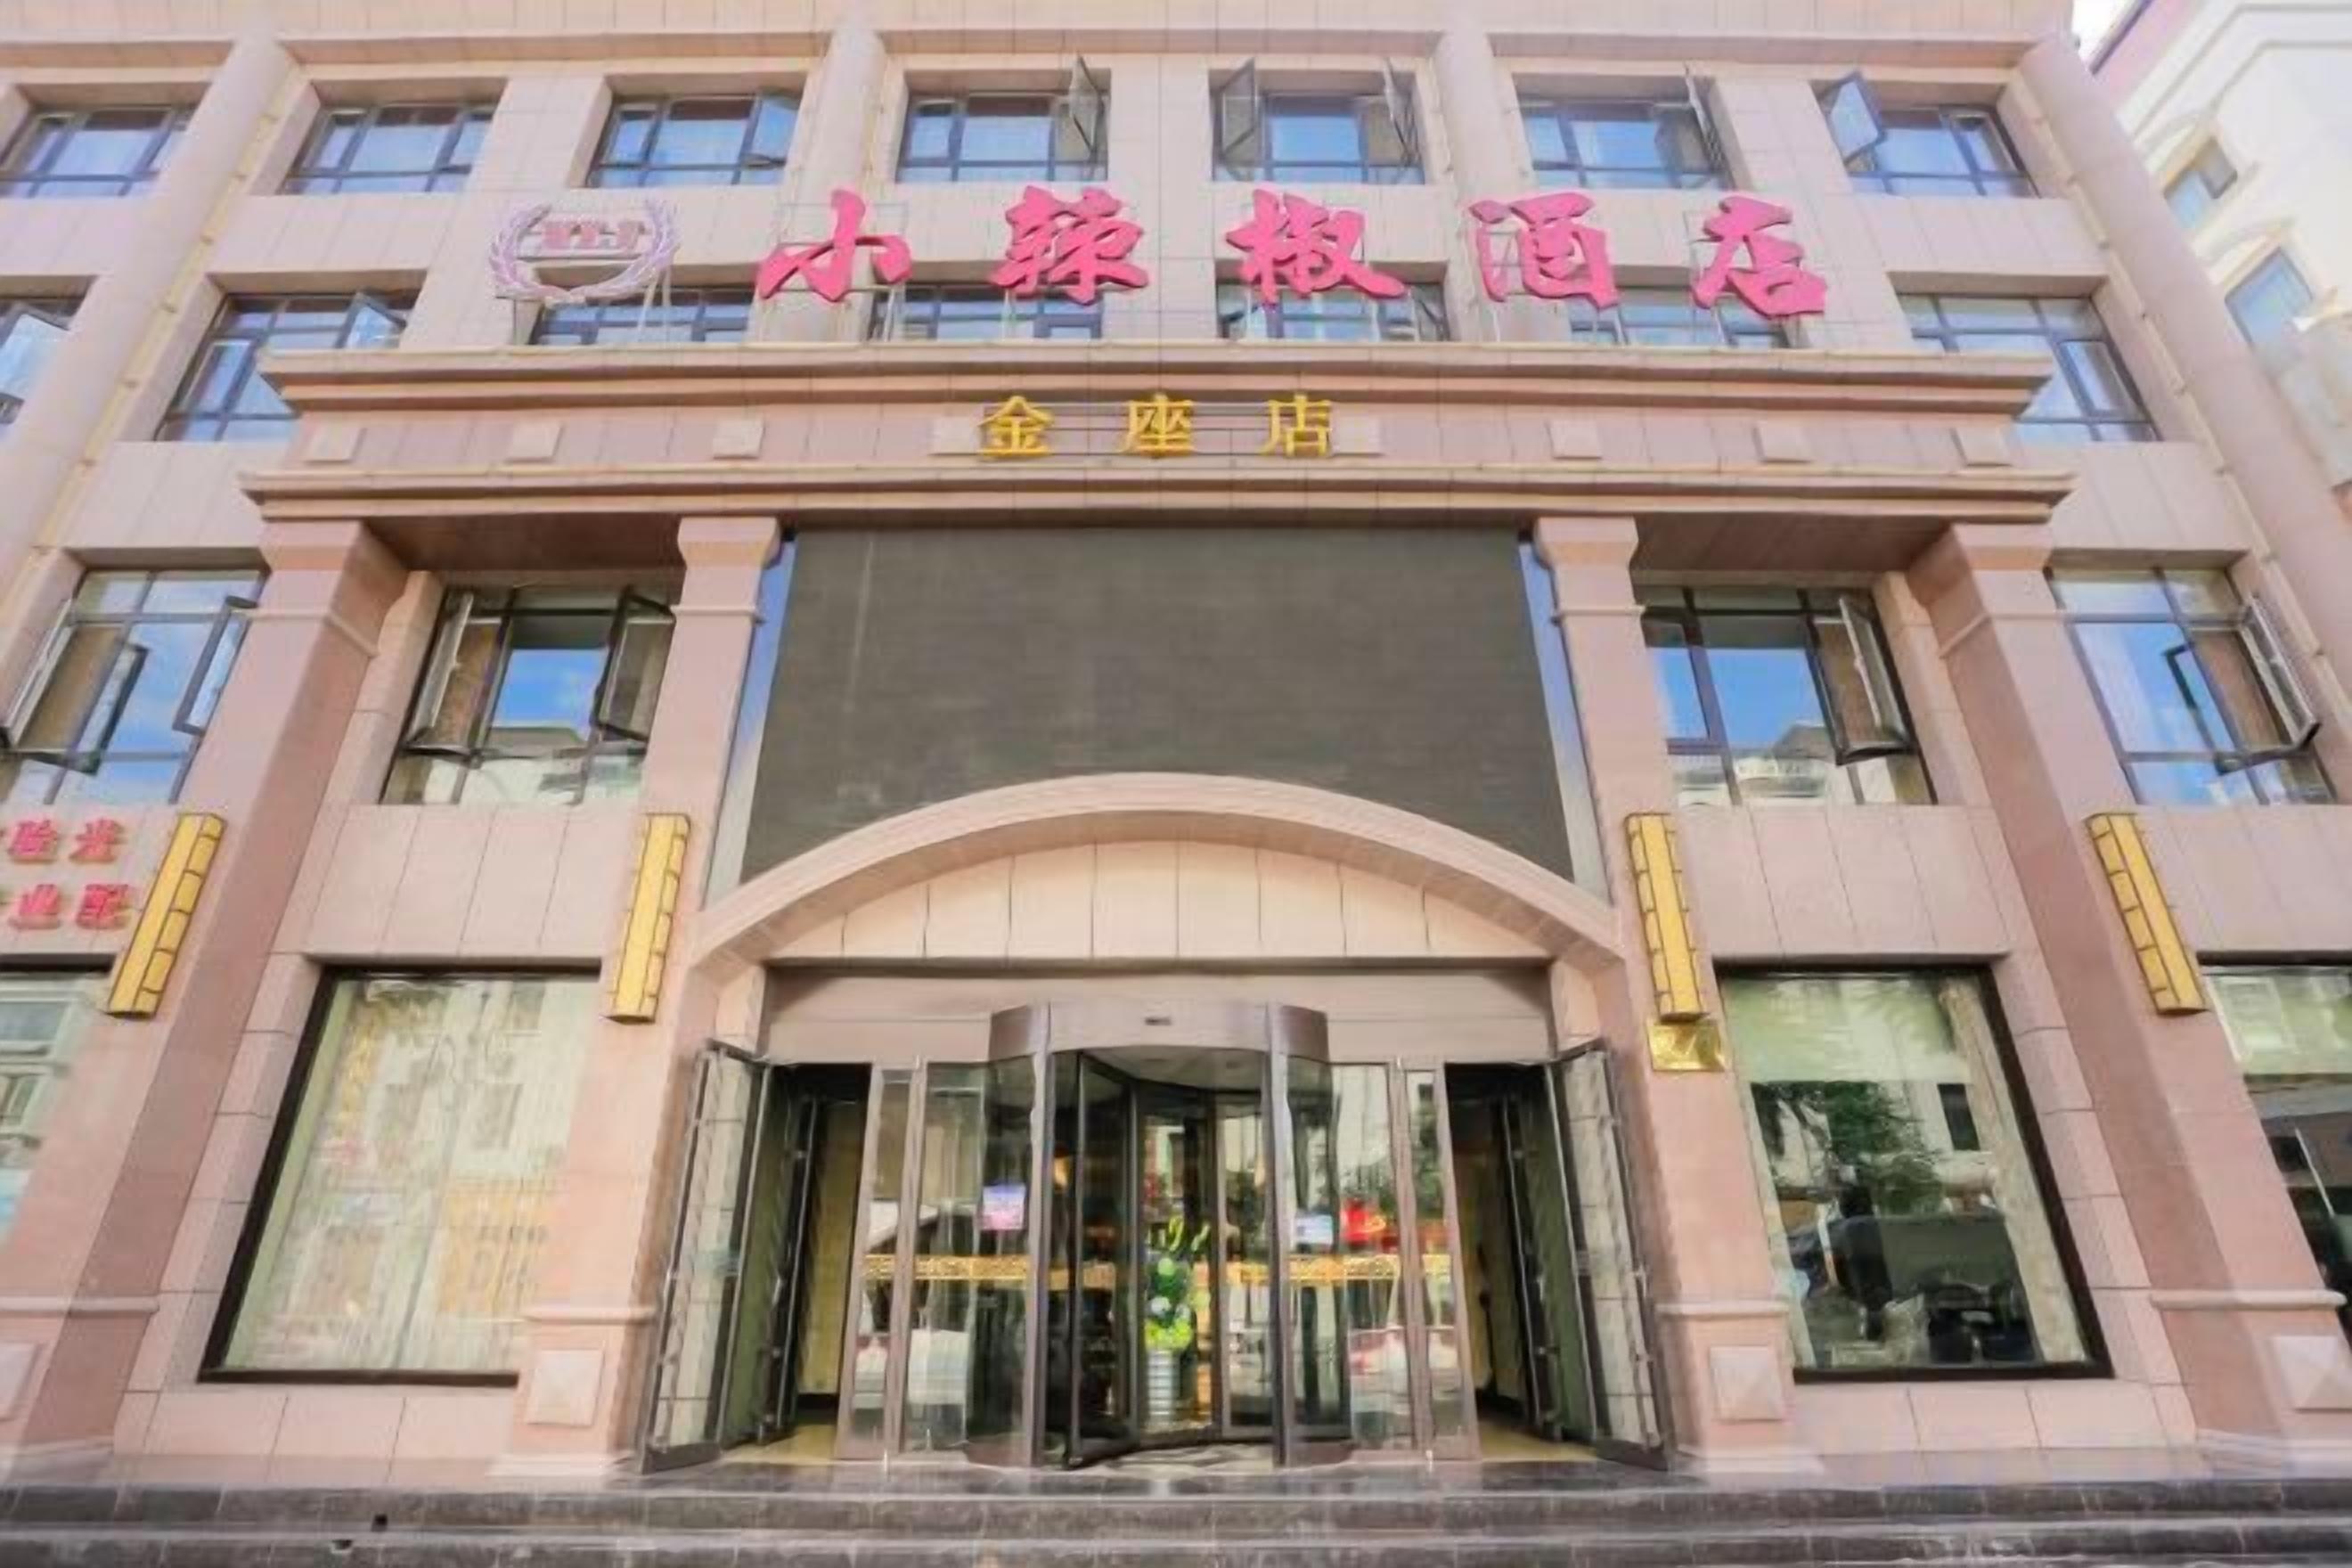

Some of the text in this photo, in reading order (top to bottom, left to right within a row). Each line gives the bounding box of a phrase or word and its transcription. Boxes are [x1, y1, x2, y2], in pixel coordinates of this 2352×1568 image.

[755, 184, 1826, 319] 小辣椒酒店
[979, 394, 1335, 458] 金座店
[0, 819, 124, 863] 验光
[0, 884, 130, 928] 业配
